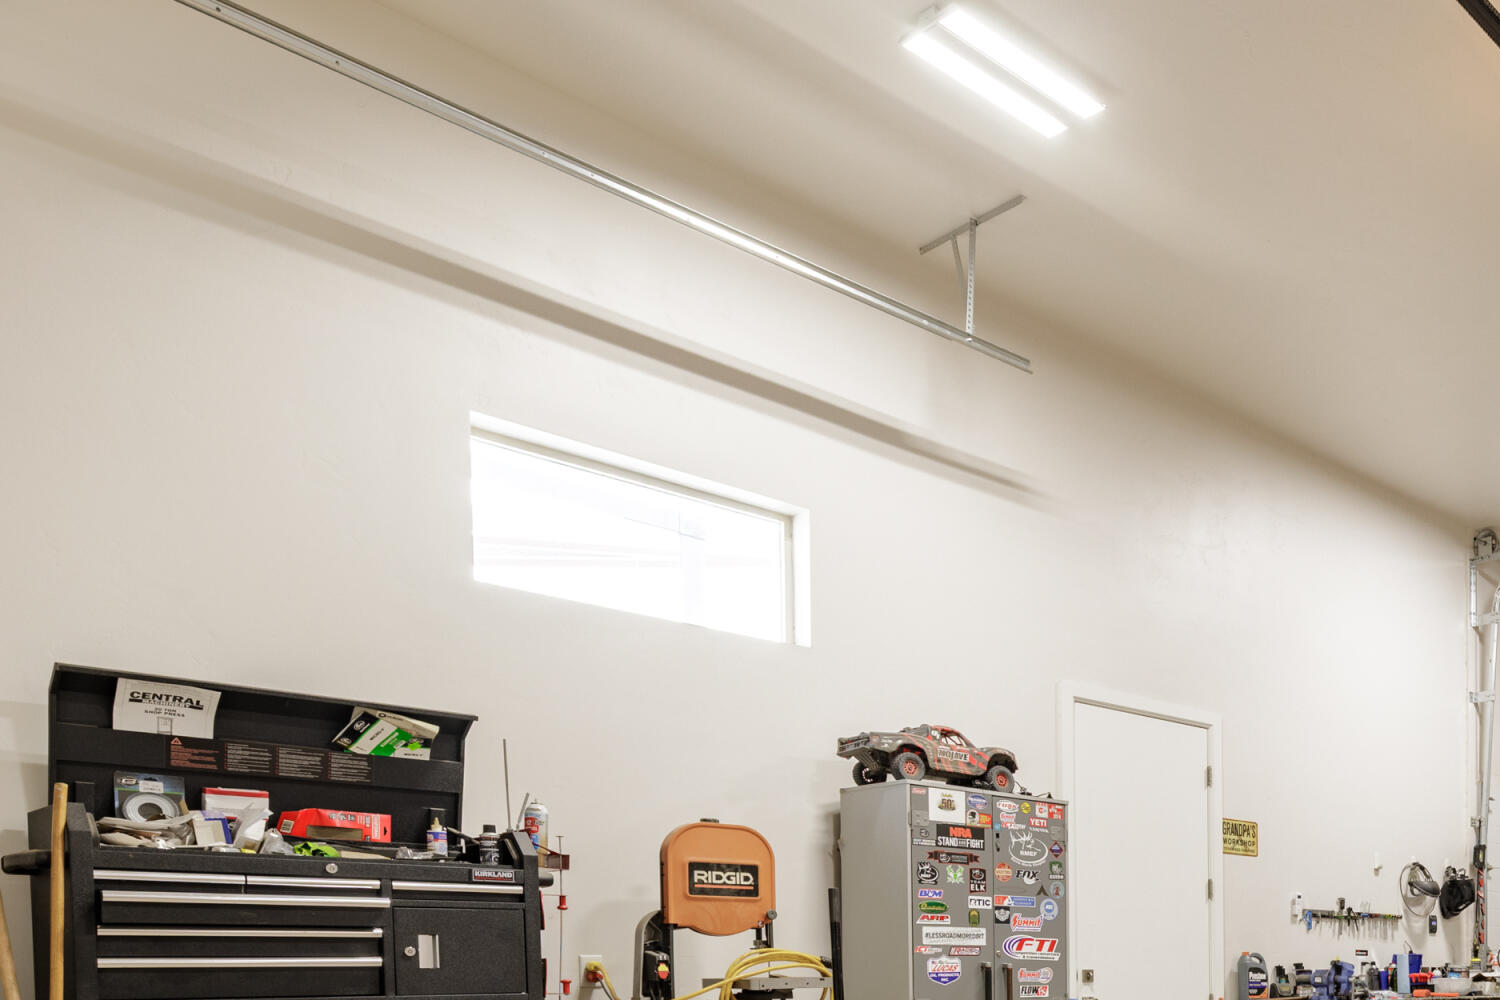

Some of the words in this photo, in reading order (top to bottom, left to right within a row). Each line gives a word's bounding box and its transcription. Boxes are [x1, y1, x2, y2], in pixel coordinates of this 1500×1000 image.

[129, 691, 204, 709] CENTRAL
[1031, 818, 1047, 826] YETI
[1222, 821, 1256, 839] GRANDPA'S
[937, 836, 958, 847] STAND
[966, 838, 984, 849] FIGHT
[1222, 837, 1256, 847] WORKSHOP
[474, 870, 513, 878] KIRKLAND
[694, 870, 754, 885] RIDGID
[1015, 869, 1039, 880] FOX
[1015, 938, 1057, 952] FTI
